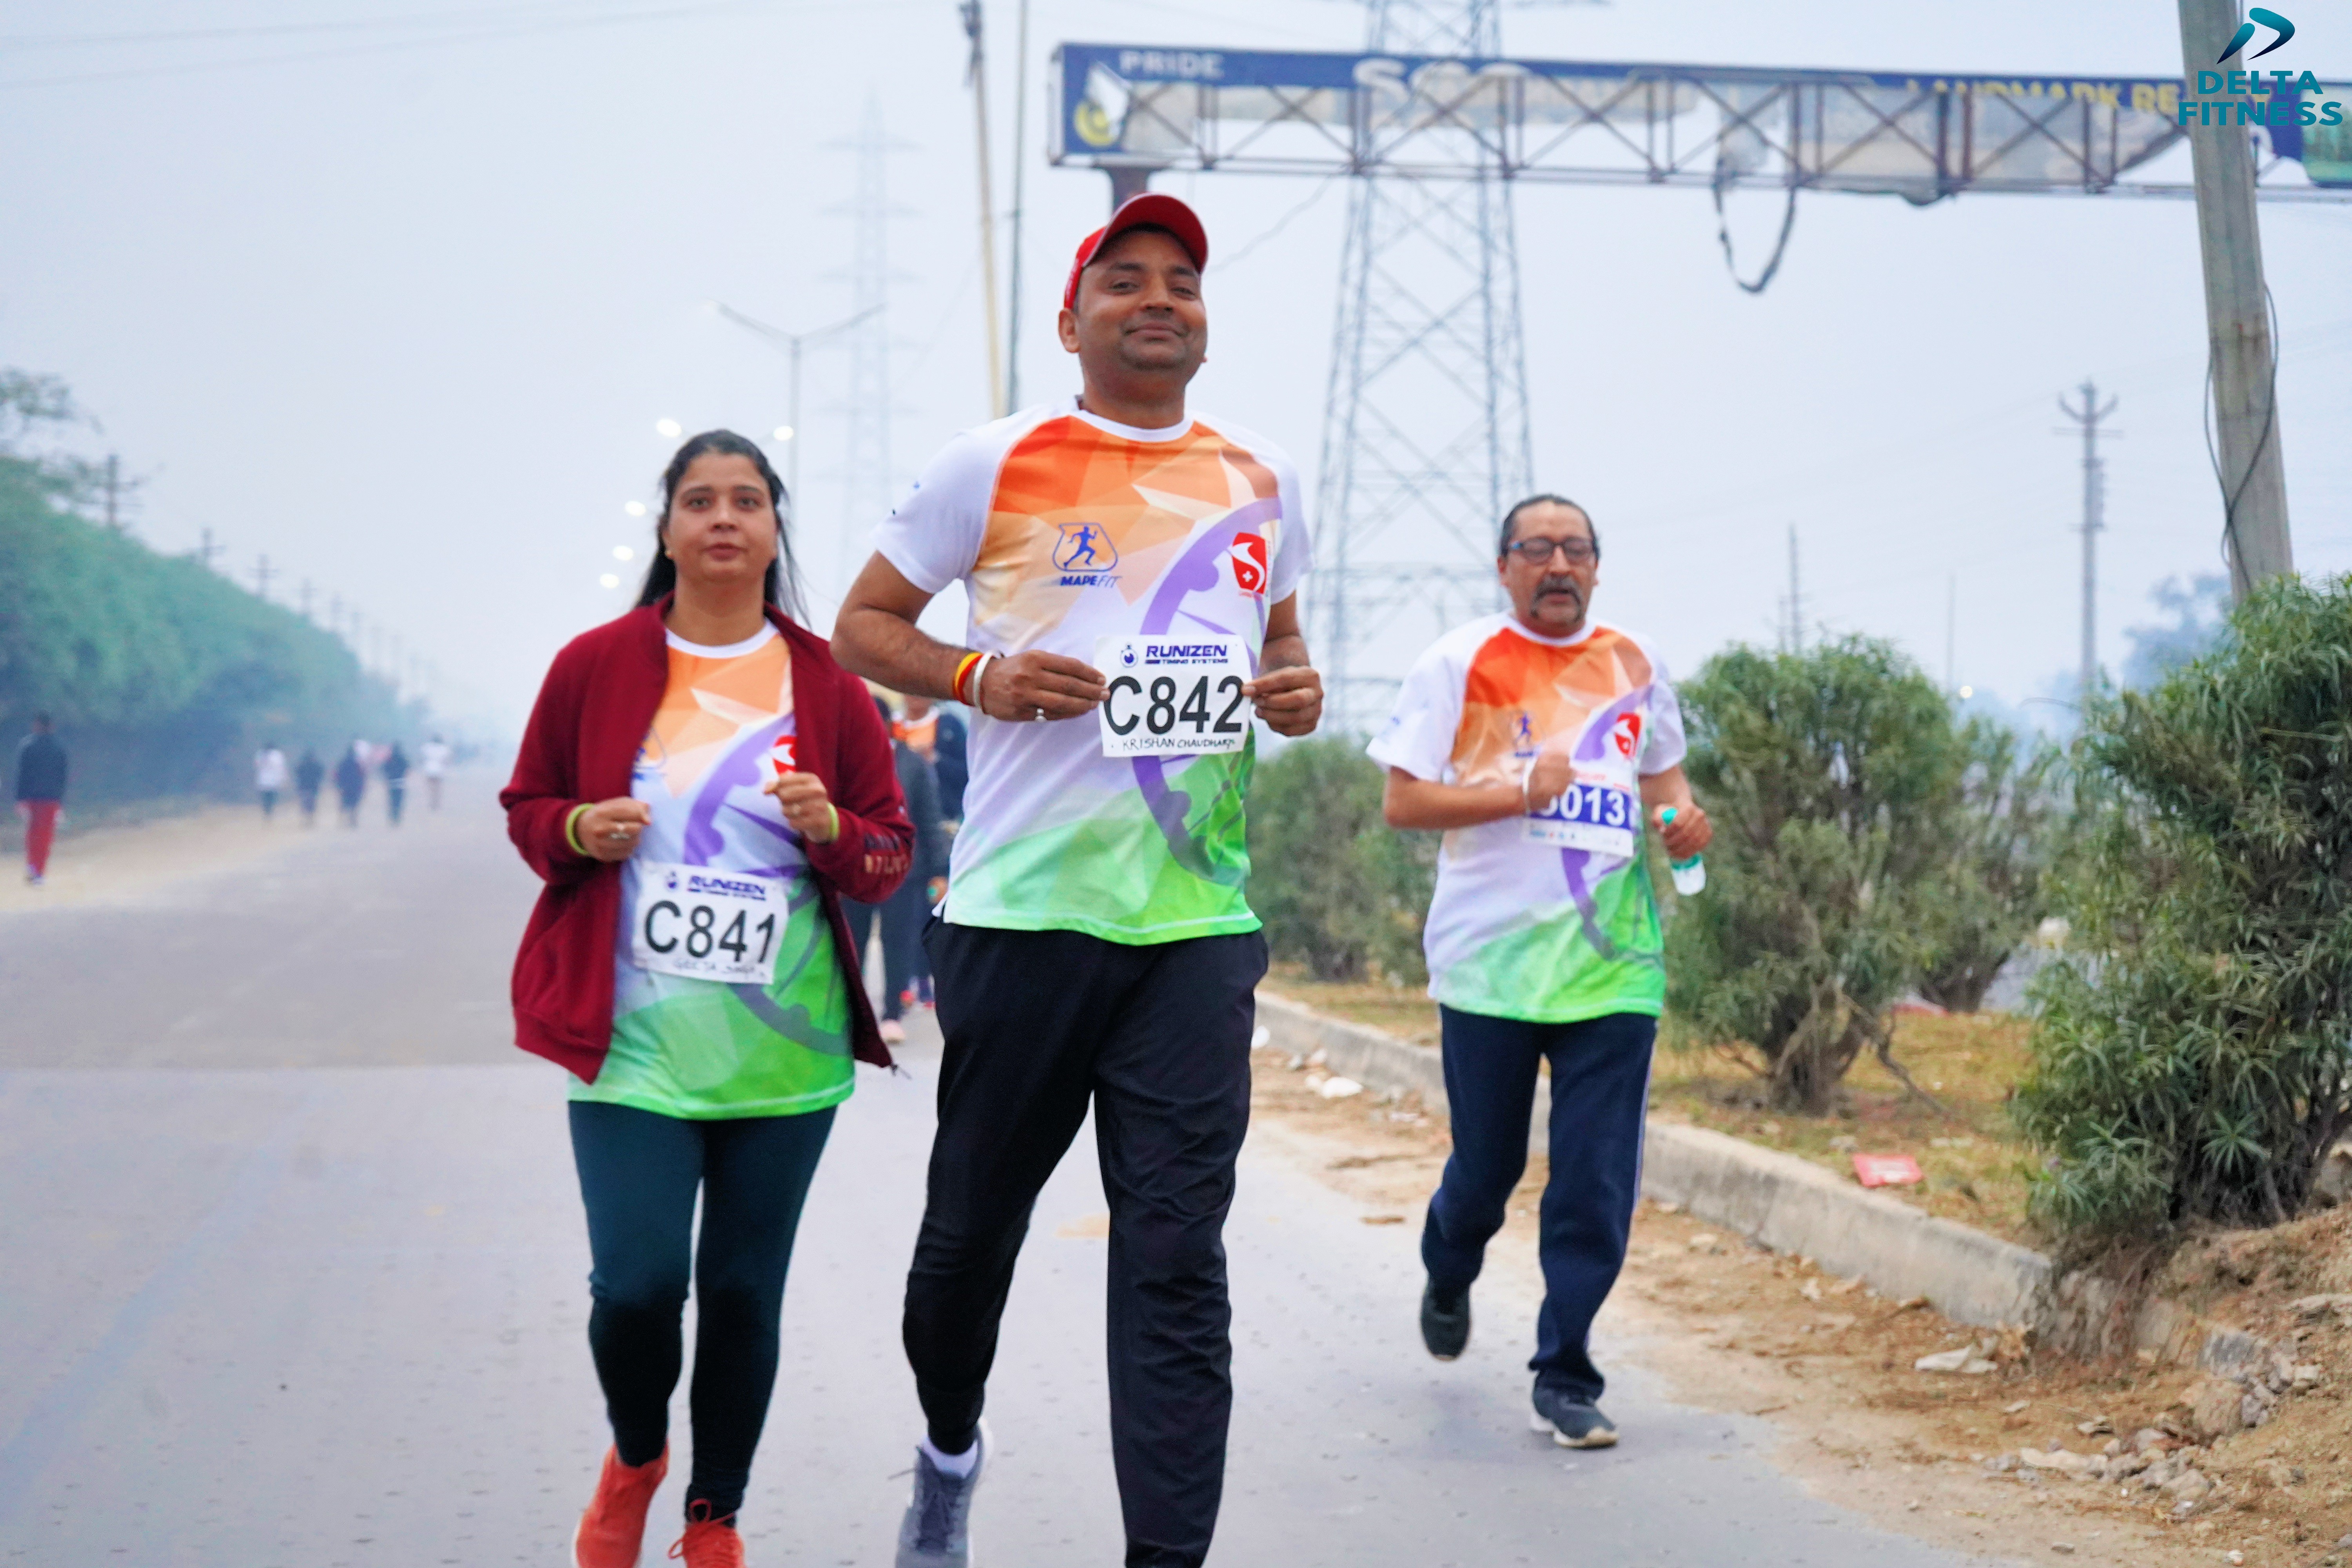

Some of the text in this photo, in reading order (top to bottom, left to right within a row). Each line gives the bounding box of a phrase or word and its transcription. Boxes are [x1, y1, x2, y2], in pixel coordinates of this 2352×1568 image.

[1119, 50, 1225, 78] PRIDE
[1146, 645, 1227, 657] RUNIZEN
[1103, 676, 1244, 735] C842
[644, 900, 776, 963] C841
